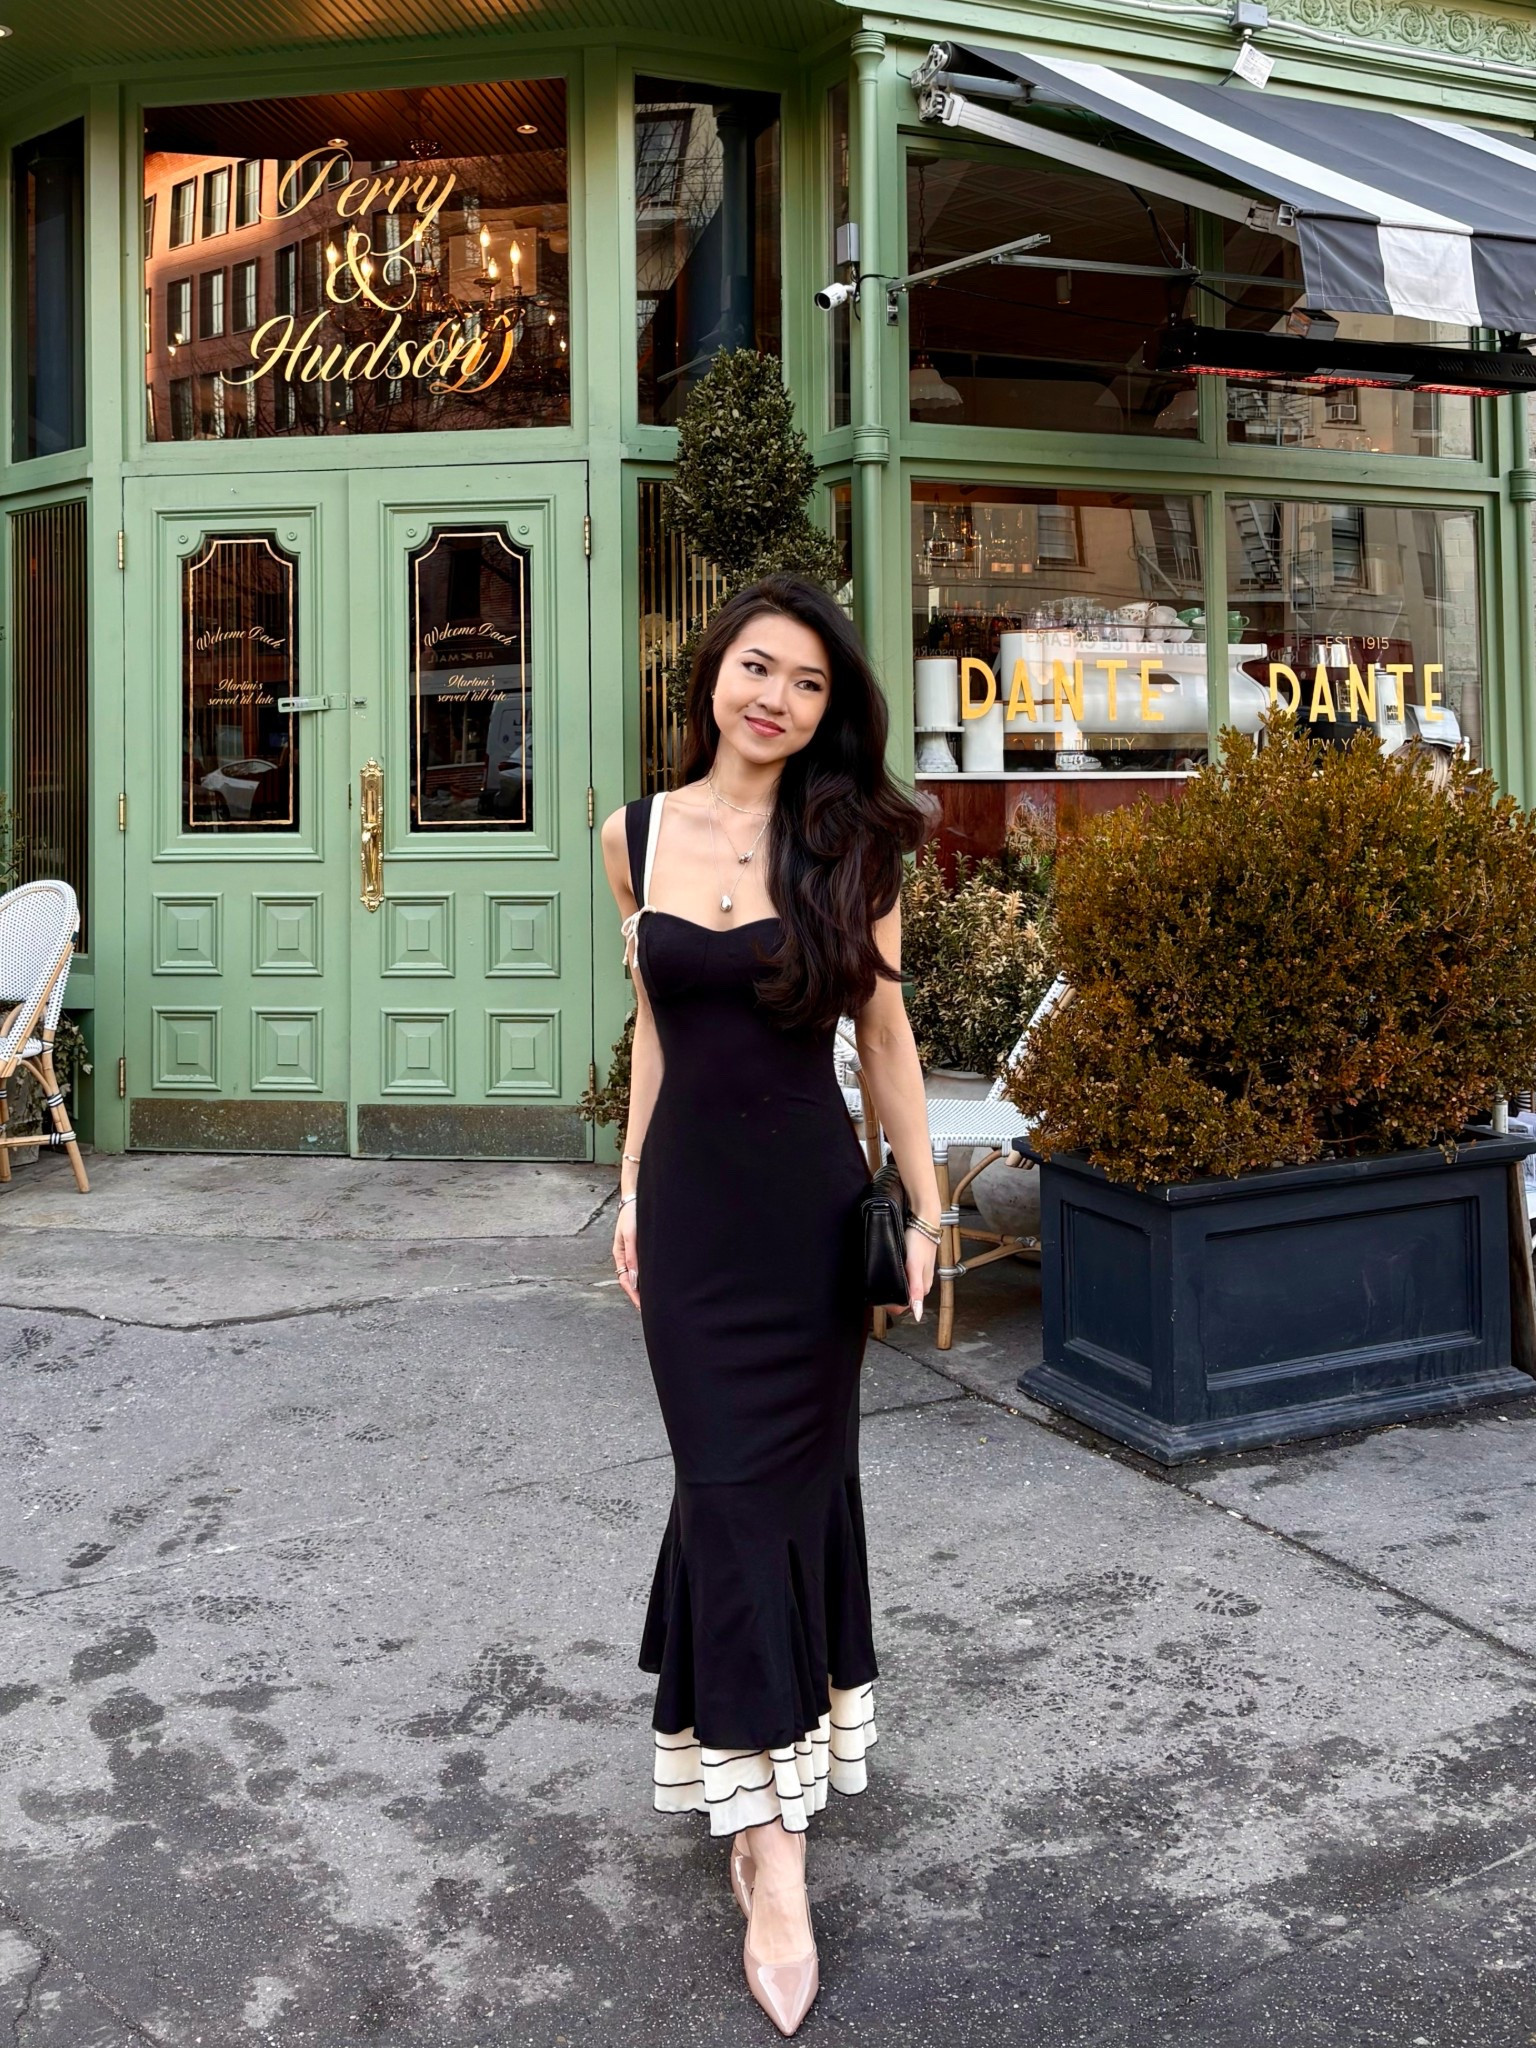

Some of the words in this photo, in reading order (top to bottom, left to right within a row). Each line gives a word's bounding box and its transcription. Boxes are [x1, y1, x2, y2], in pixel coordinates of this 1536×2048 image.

[256, 146, 457, 256] Perry
[325, 232, 417, 311] &
[220, 309, 492, 385] Hudson
[196, 626, 246, 651] Welcome
[247, 626, 286, 649] Back
[424, 622, 477, 647] Welcome
[477, 622, 518, 646] Back
[1325, 636, 1357, 650] EST.
[1362, 636, 1390, 650] 1915
[446, 674, 495, 689] Martini's
[961, 657, 1165, 722] DANTE
[1268, 662, 1445, 723] DANTE
[207, 692, 240, 705] served
[255, 692, 274, 705] late
[438, 690, 471, 703] served
[488, 688, 508, 702] late
